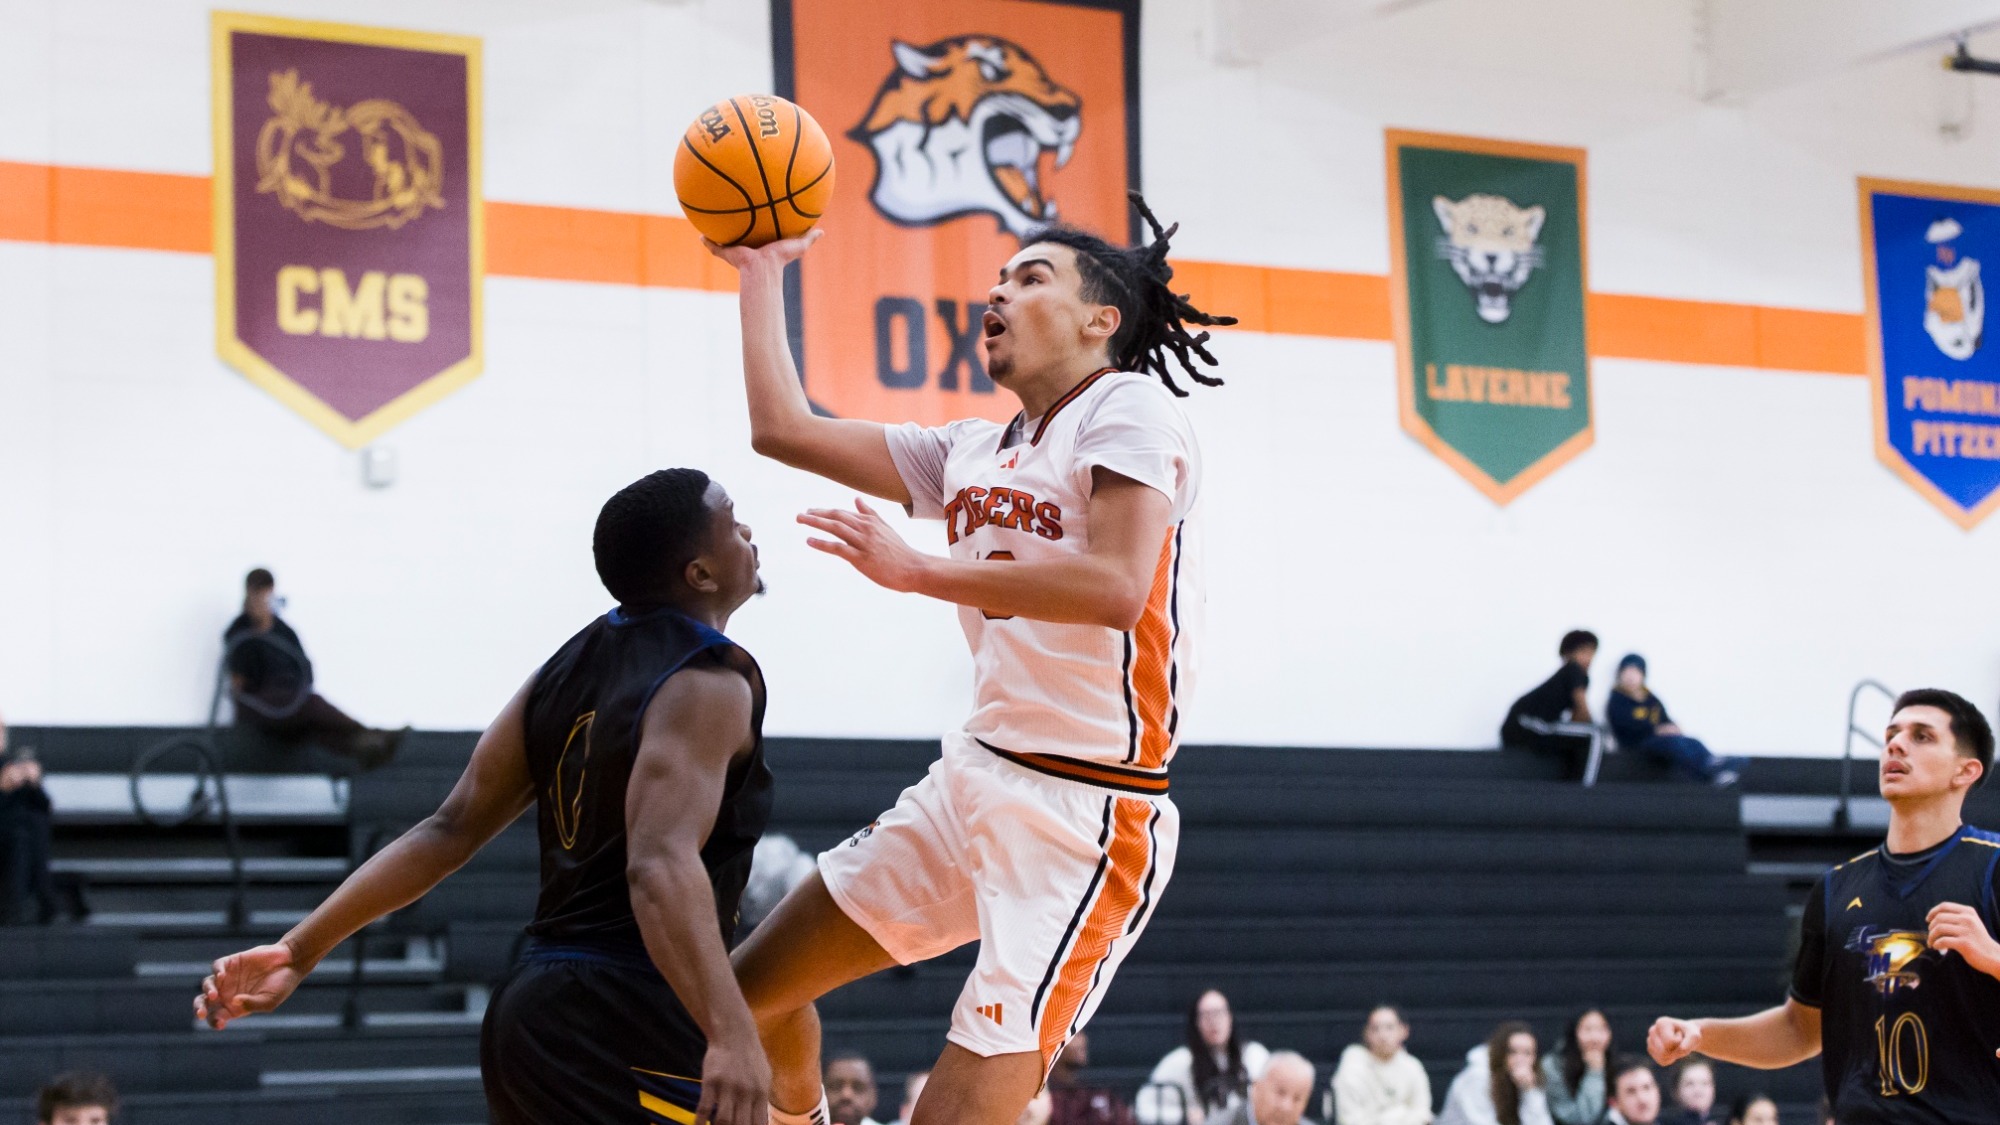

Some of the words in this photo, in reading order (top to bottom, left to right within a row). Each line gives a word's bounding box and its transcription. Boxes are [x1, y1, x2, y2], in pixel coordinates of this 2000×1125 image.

[700, 105, 732, 144] CAA
[276, 264, 429, 343] CMS
[875, 296, 995, 393] OX
[1426, 363, 1571, 409] LAVERNE
[1902, 375, 2000, 417] POMON
[944, 485, 1063, 546] TIGERS
[1874, 1011, 1929, 1097] 10
